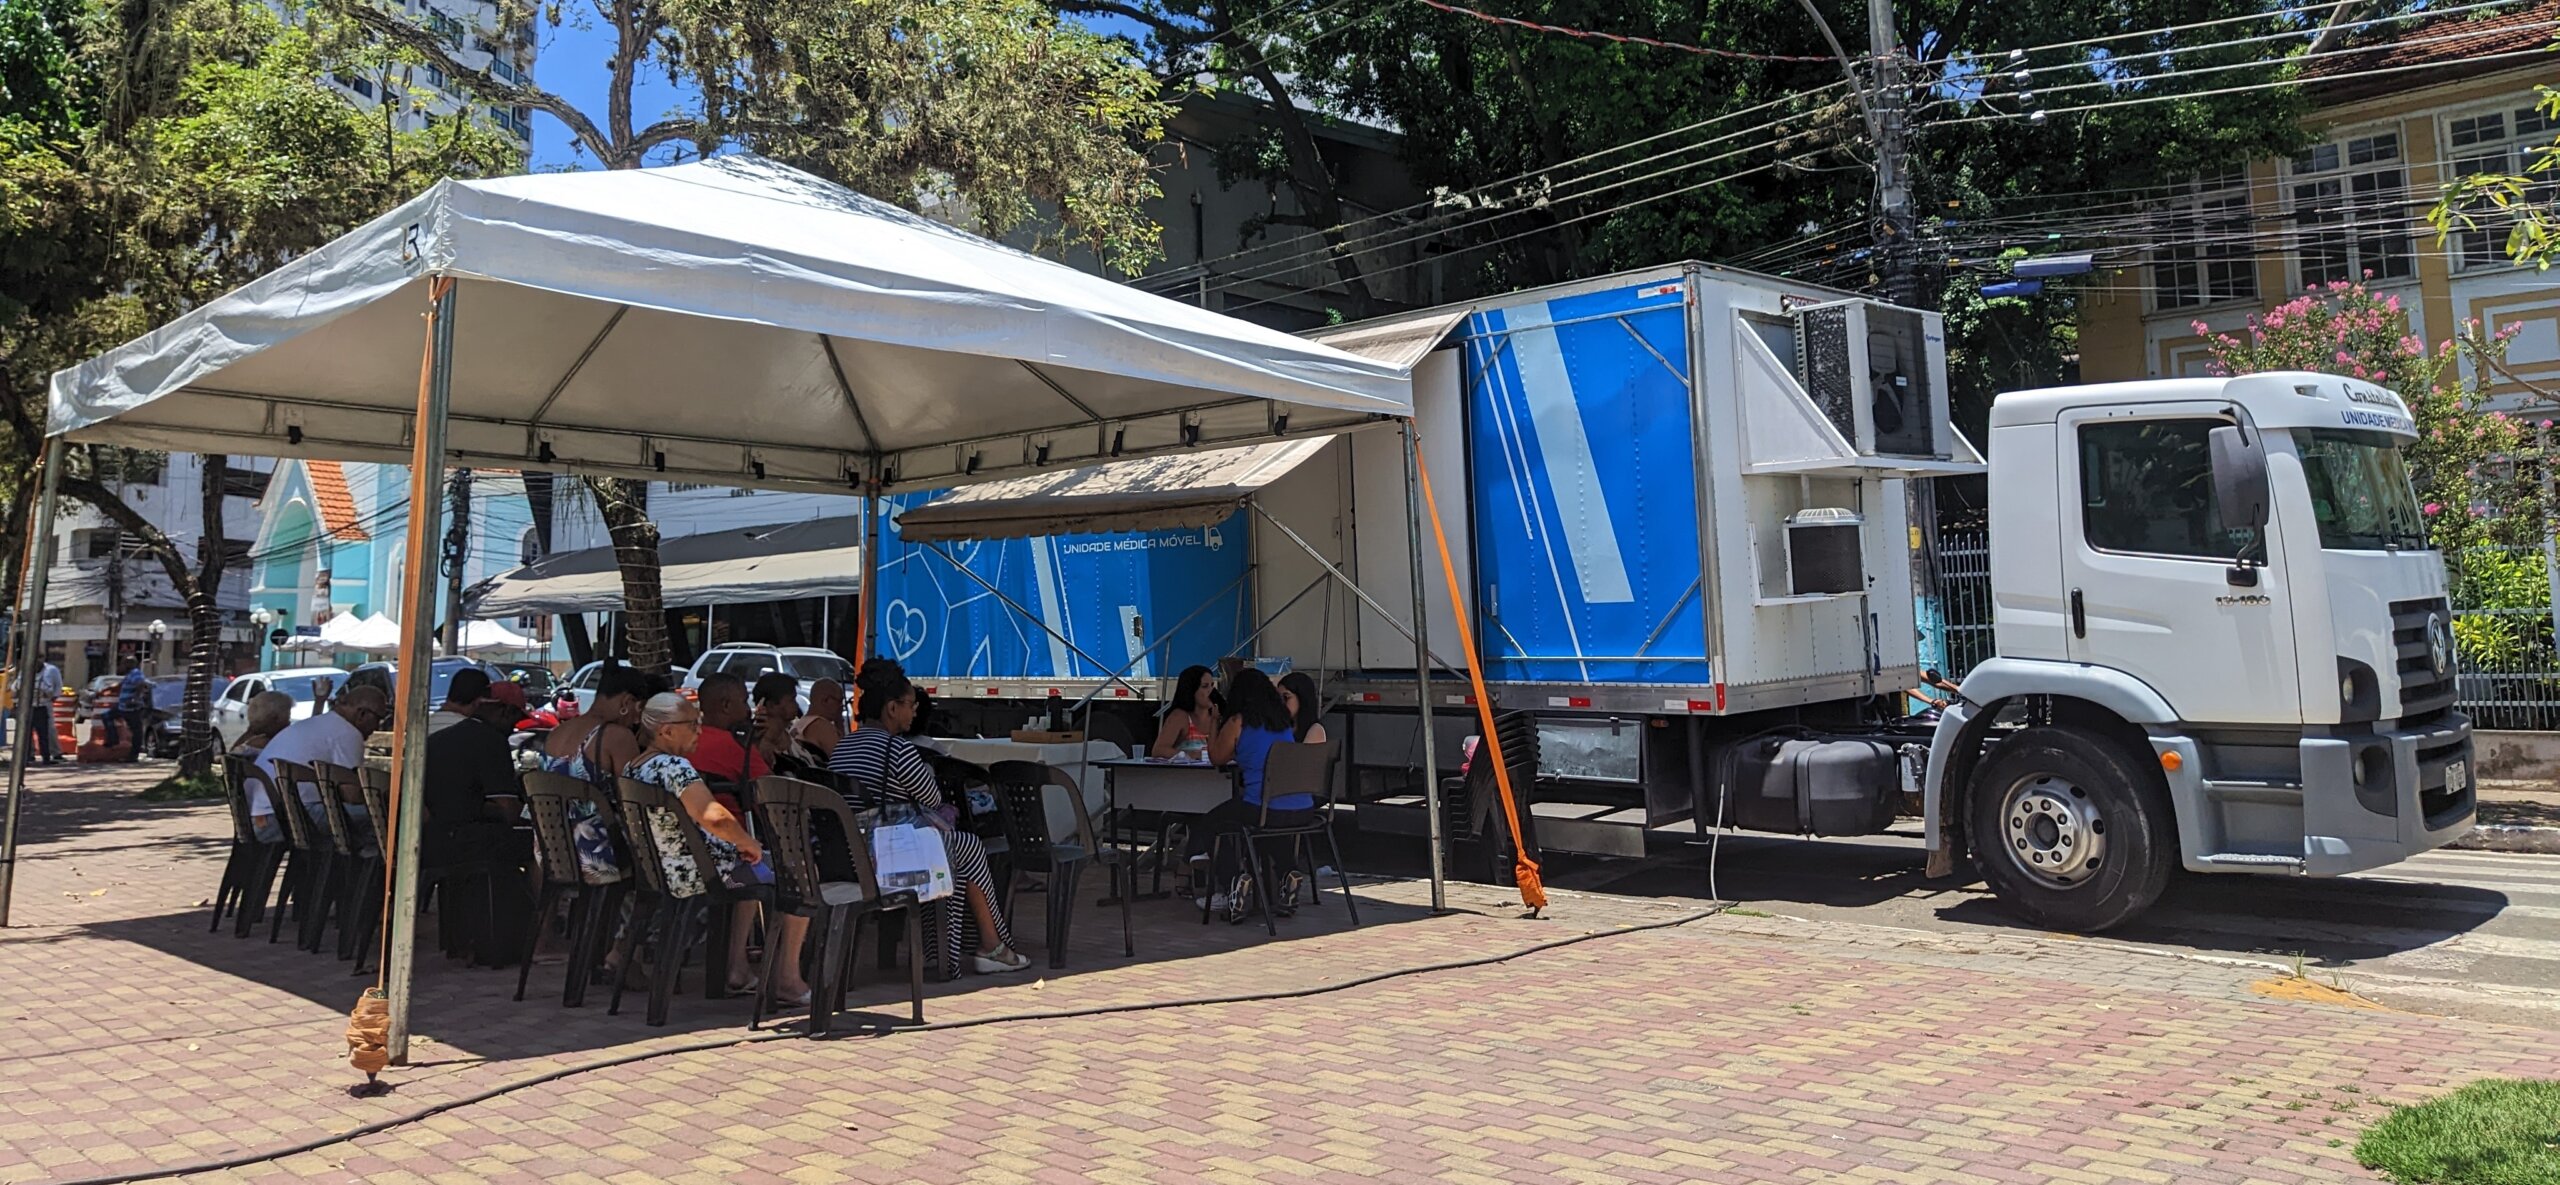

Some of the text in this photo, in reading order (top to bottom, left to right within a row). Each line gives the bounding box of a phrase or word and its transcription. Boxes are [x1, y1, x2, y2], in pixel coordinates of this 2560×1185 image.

[2341, 410, 2386, 428] UNIDADE
[1064, 533, 1201, 554] UNIDADE MÉDICA MÓVEL
